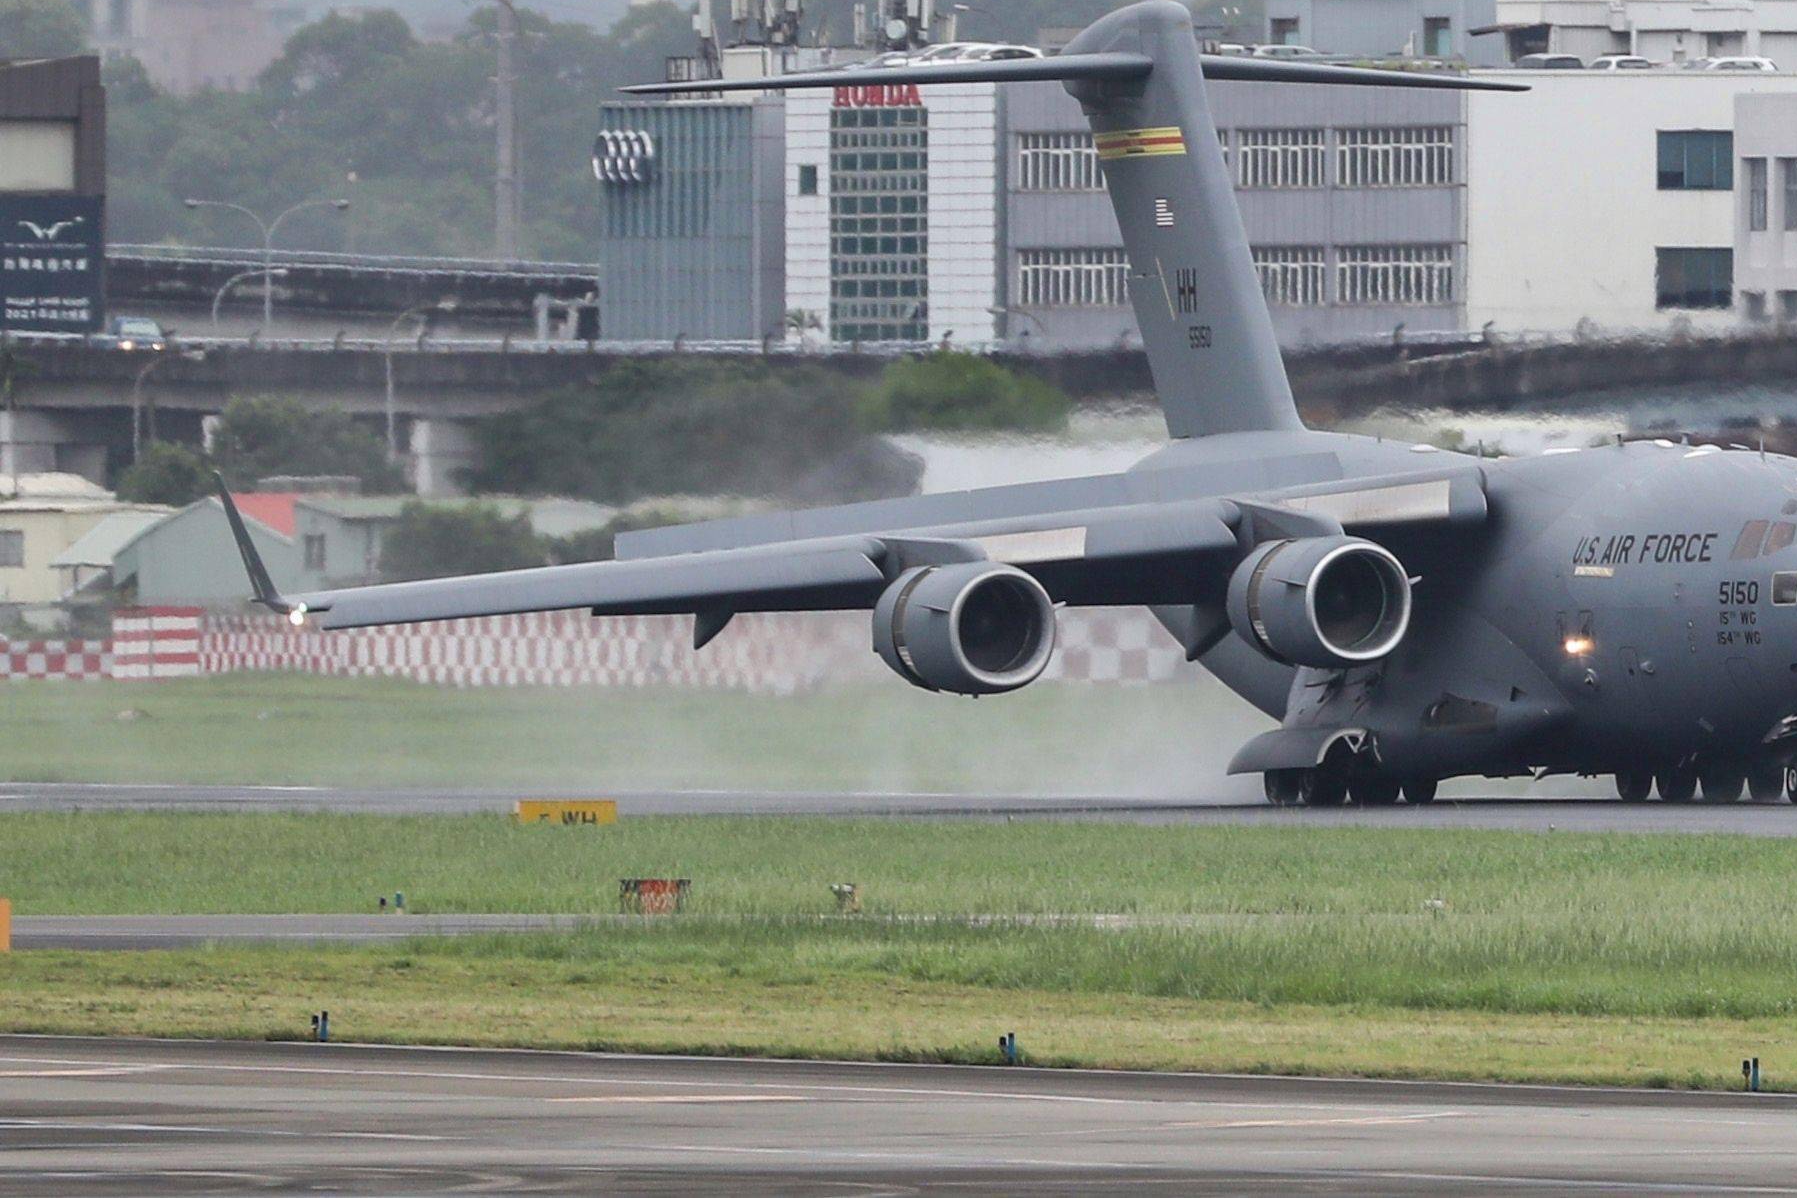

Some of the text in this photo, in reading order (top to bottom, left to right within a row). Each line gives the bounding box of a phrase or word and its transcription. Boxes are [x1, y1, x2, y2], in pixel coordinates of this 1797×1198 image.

[1176, 267, 1197, 313] HH
[1572, 532, 1719, 564] U.S. AIR FORCE
[1719, 581, 1759, 605] 5150
[1740, 611, 1757, 625] WG
